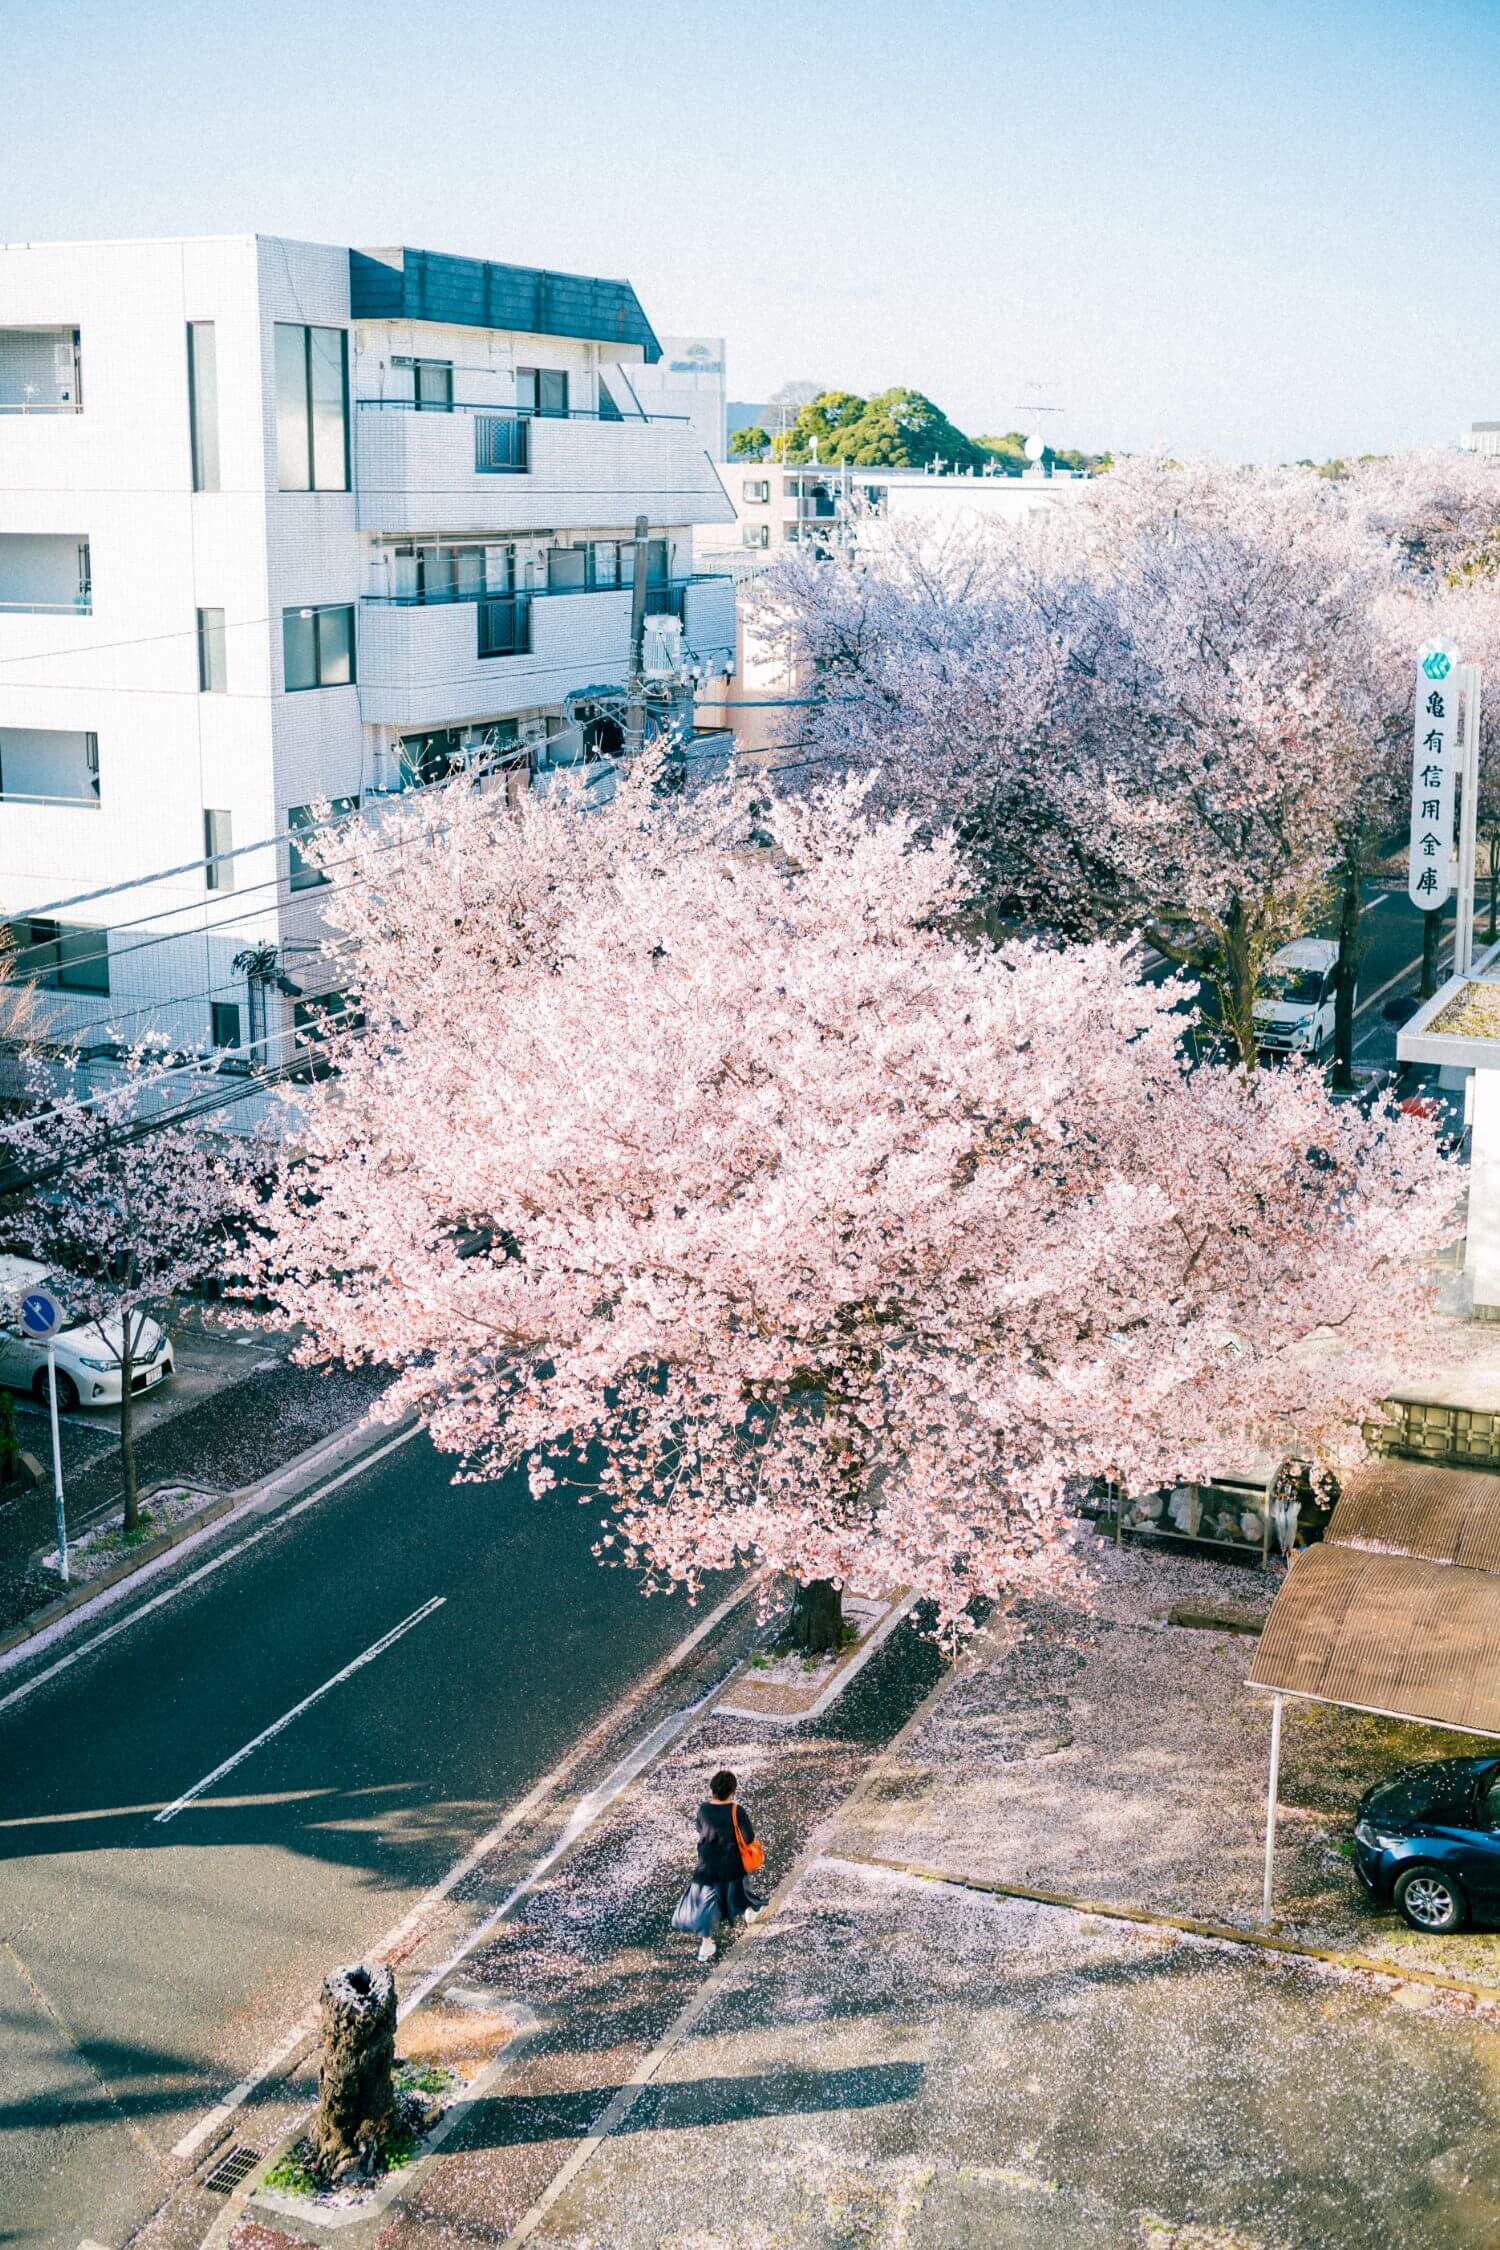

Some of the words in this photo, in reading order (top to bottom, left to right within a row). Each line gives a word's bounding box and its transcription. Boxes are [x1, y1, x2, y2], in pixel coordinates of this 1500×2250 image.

[1416, 690, 1445, 895] 亀有信用金庫
